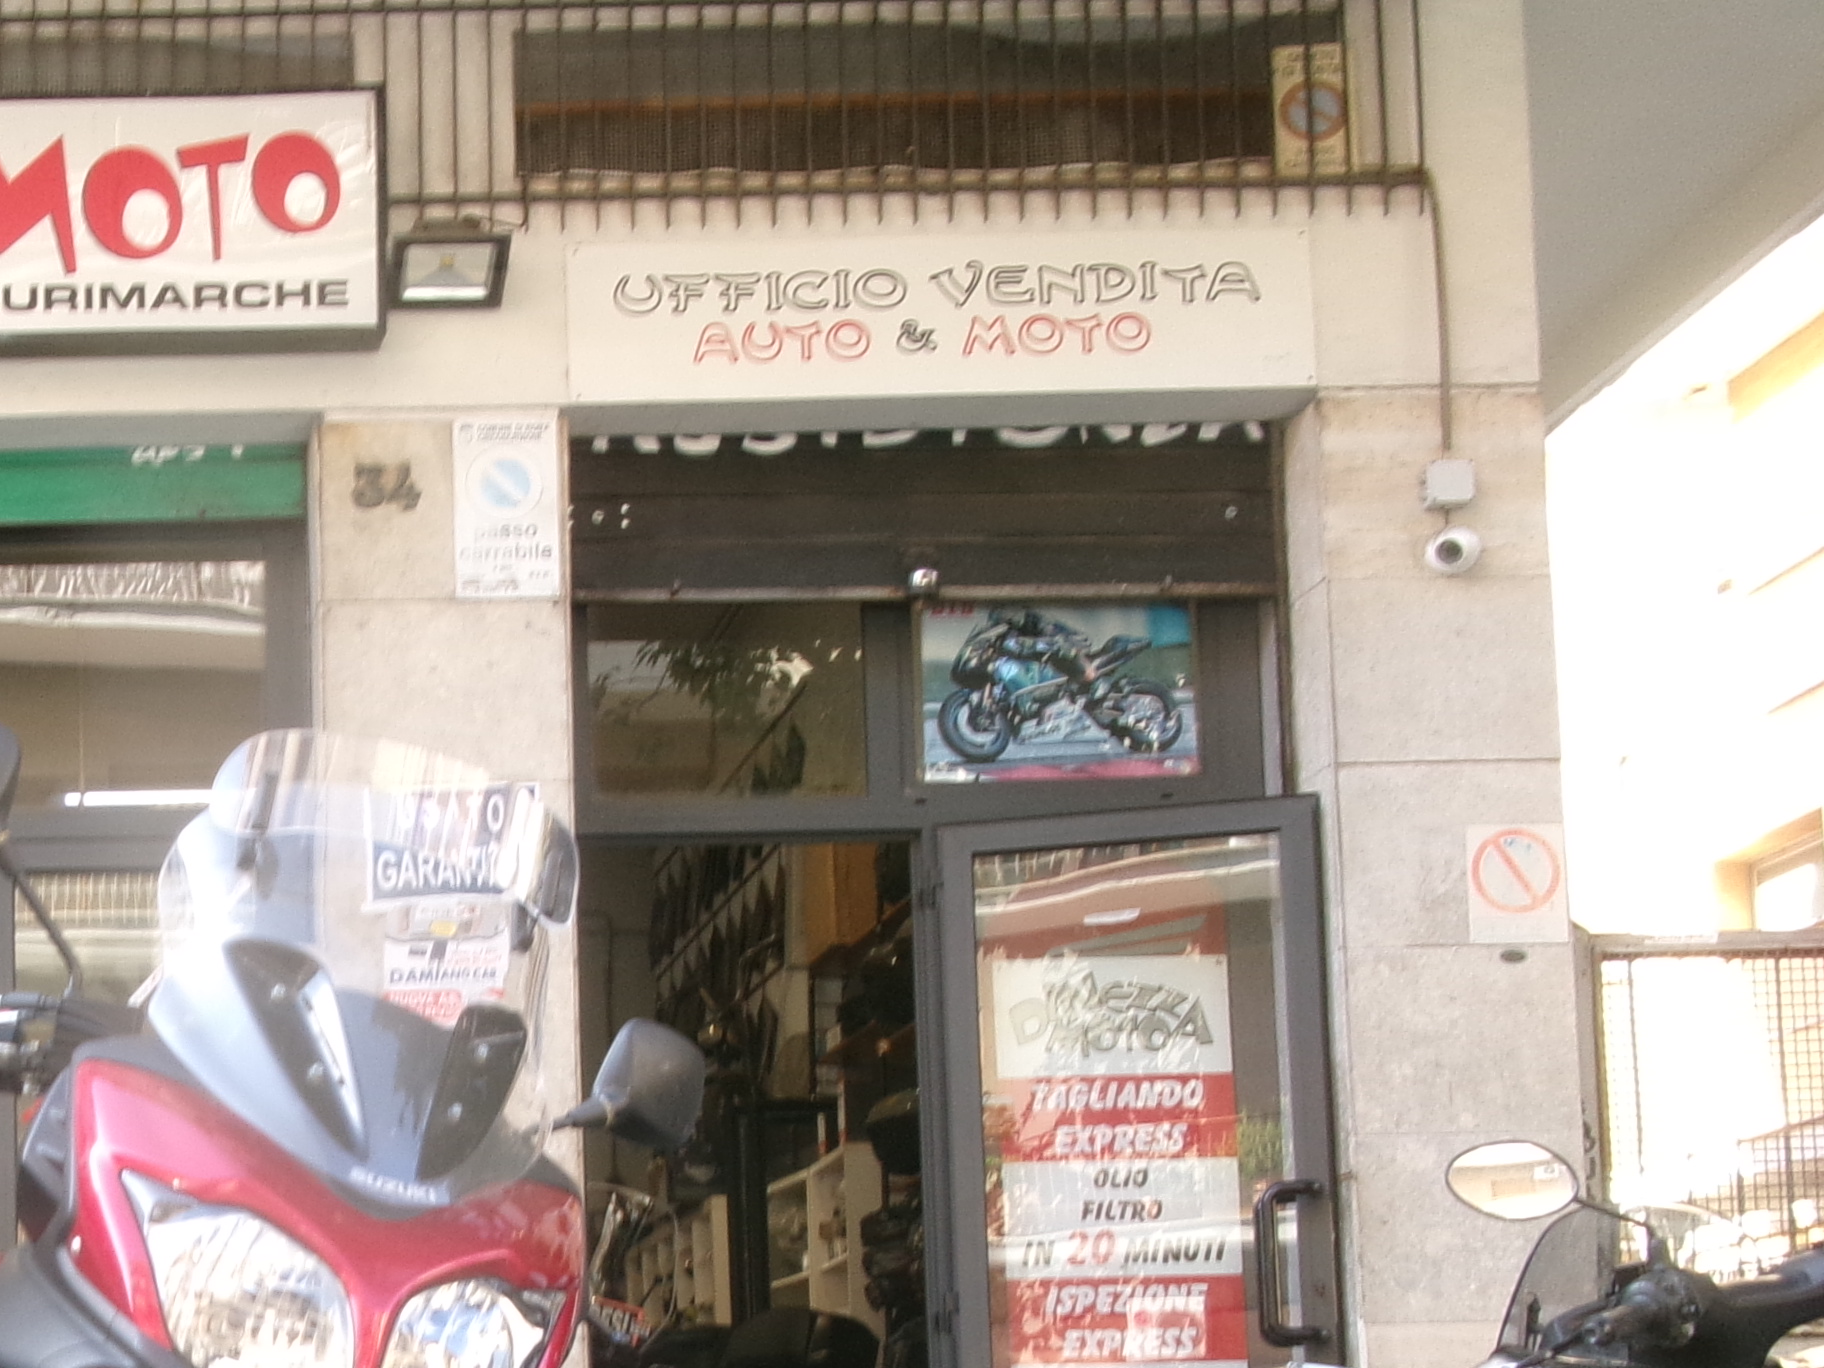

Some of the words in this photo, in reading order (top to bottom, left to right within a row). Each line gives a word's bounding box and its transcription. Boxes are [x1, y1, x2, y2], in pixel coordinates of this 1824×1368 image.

[612, 266, 908, 315] UFFICIO
[928, 258, 1263, 310] VENDITA
[691, 318, 873, 366] AUTO
[894, 318, 938, 356] &
[960, 312, 1154, 360] MOTO
[1031, 1078, 1205, 1113] TAGLIANDO
[1055, 1122, 1189, 1155] EXPRESS
[1093, 1166, 1149, 1189] OLIO
[1080, 1199, 1163, 1222] FILTRO
[1022, 1239, 1057, 1267] IN
[1066, 1228, 1116, 1266] 20
[1122, 1235, 1229, 1268] MINUTI
[1043, 1282, 1209, 1319] ISPEZIONE
[1061, 1325, 1199, 1359] EXPRESS
